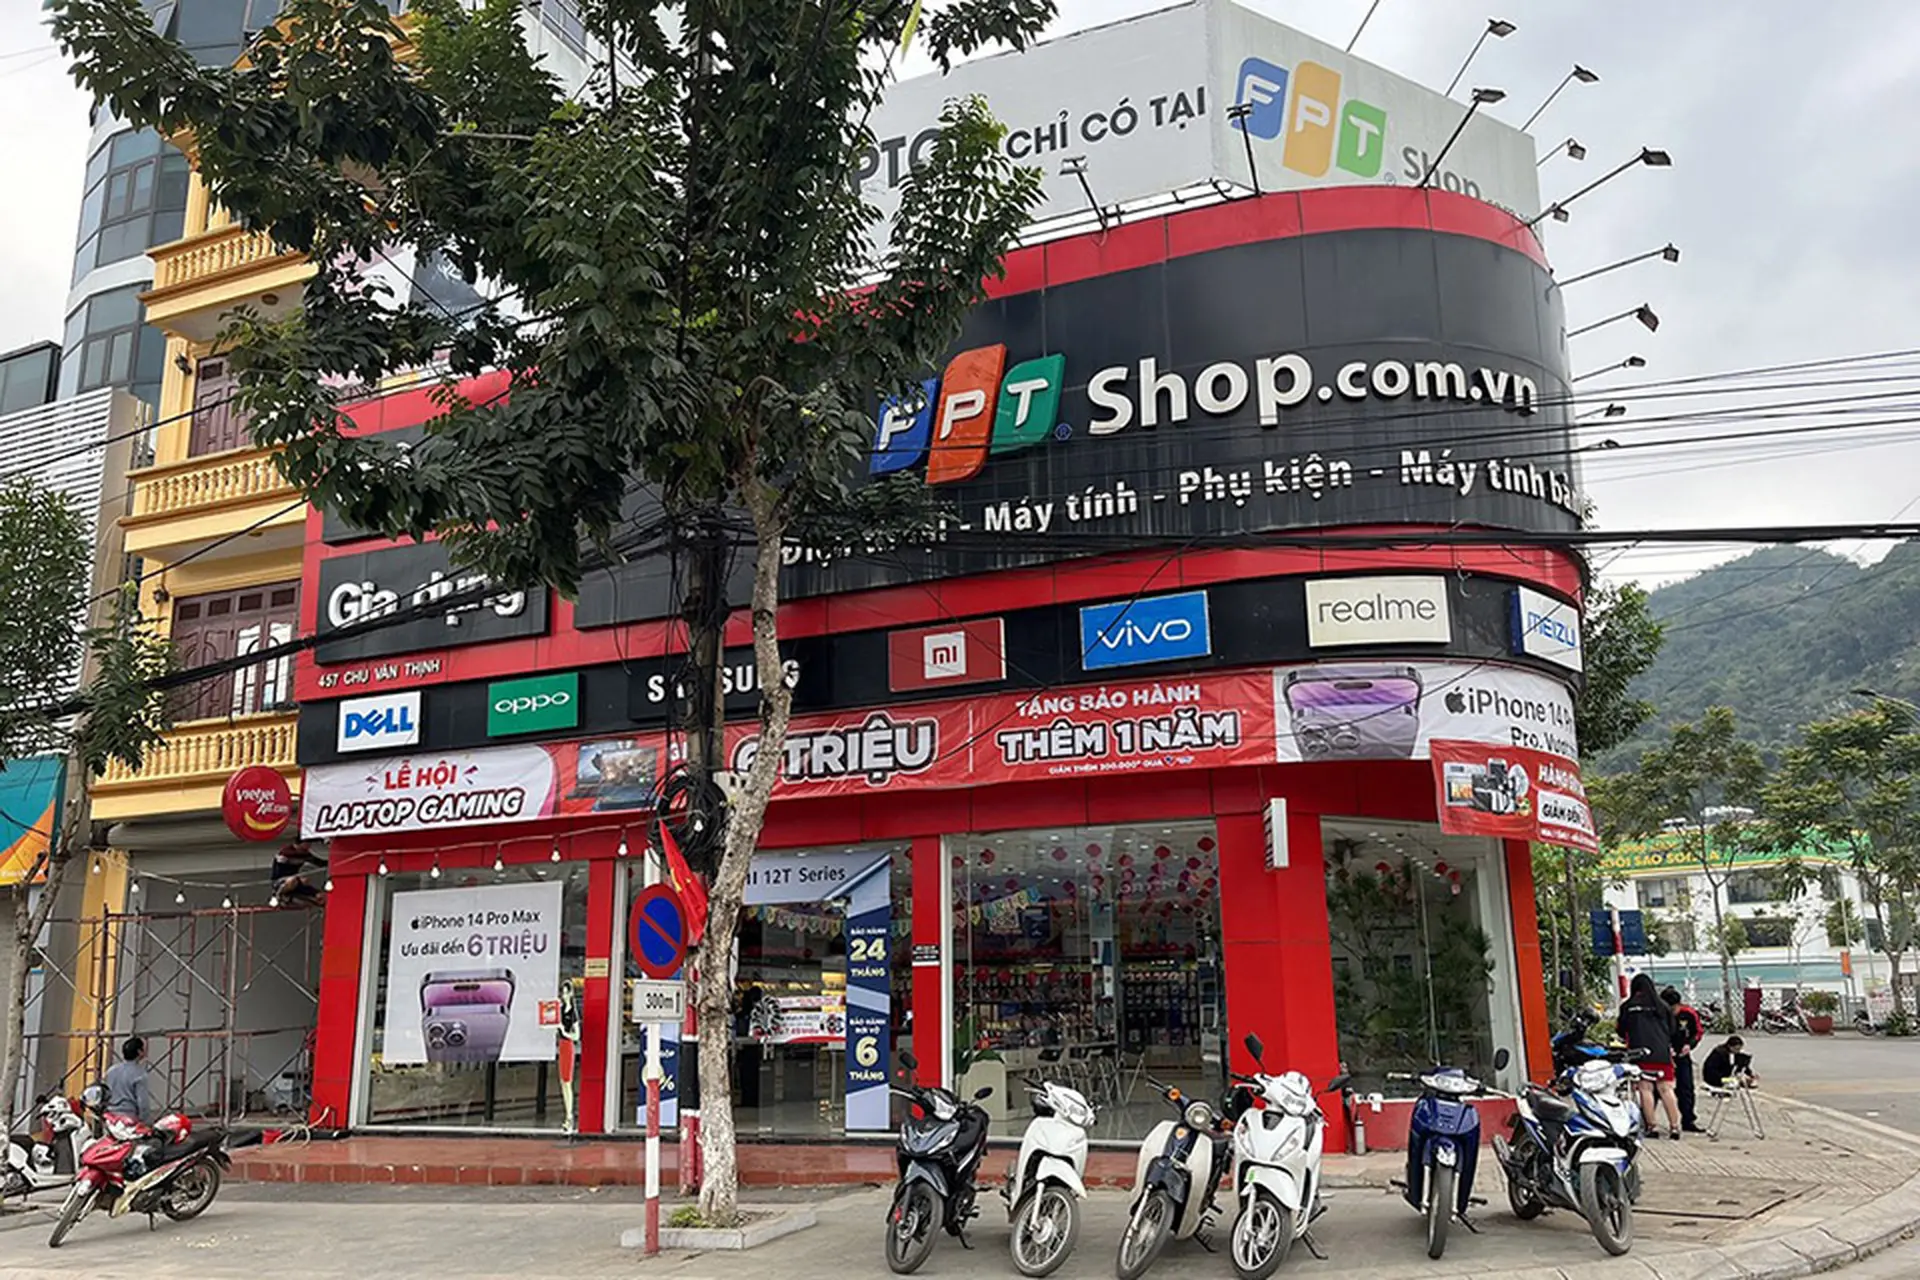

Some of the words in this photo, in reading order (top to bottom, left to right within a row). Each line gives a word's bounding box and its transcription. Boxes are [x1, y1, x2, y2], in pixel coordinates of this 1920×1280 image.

[1005, 109, 1069, 160] CHỈ
[1080, 96, 1139, 143] CÓ
[1149, 85, 1207, 130] TẠI
[1240, 72, 1382, 159] FPT
[1086, 352, 1539, 437] Shop.com.vn
[984, 499, 1053, 534] Máy
[1065, 481, 1138, 522] tính
[1178, 467, 1252, 507] Phụ
[1263, 452, 1353, 499] kiện
[1400, 448, 1478, 496] Máy
[1486, 457, 1546, 499] tính
[328, 580, 400, 630] Gia
[1317, 593, 1438, 624] realme
[647, 659, 800, 703] SSUG
[494, 691, 571, 715] oppo
[1015, 694, 1076, 720] TẶNG
[1080, 686, 1127, 712] BẢO
[1133, 683, 1201, 707] HÀNH
[1468, 687, 1546, 723] iPhone
[344, 706, 414, 739] DELL
[999, 720, 1106, 763] THÊM
[1142, 709, 1239, 750] NĂM
[781, 716, 934, 782] TRIỆU
[384, 759, 411, 791] LỄ
[416, 759, 458, 791] HỘI
[315, 798, 416, 833] LAPTOP
[417, 787, 526, 824] GAMING
[764, 868, 792, 884] 12T
[798, 865, 846, 884] Series
[421, 915, 465, 929] iPhone
[468, 912, 484, 927] 14
[487, 911, 509, 926] Pro
[512, 910, 541, 925] Max
[467, 932, 484, 957] 6
[486, 928, 548, 961] TRIỆU
[850, 937, 887, 962] 24
[854, 1035, 879, 1067] 6
